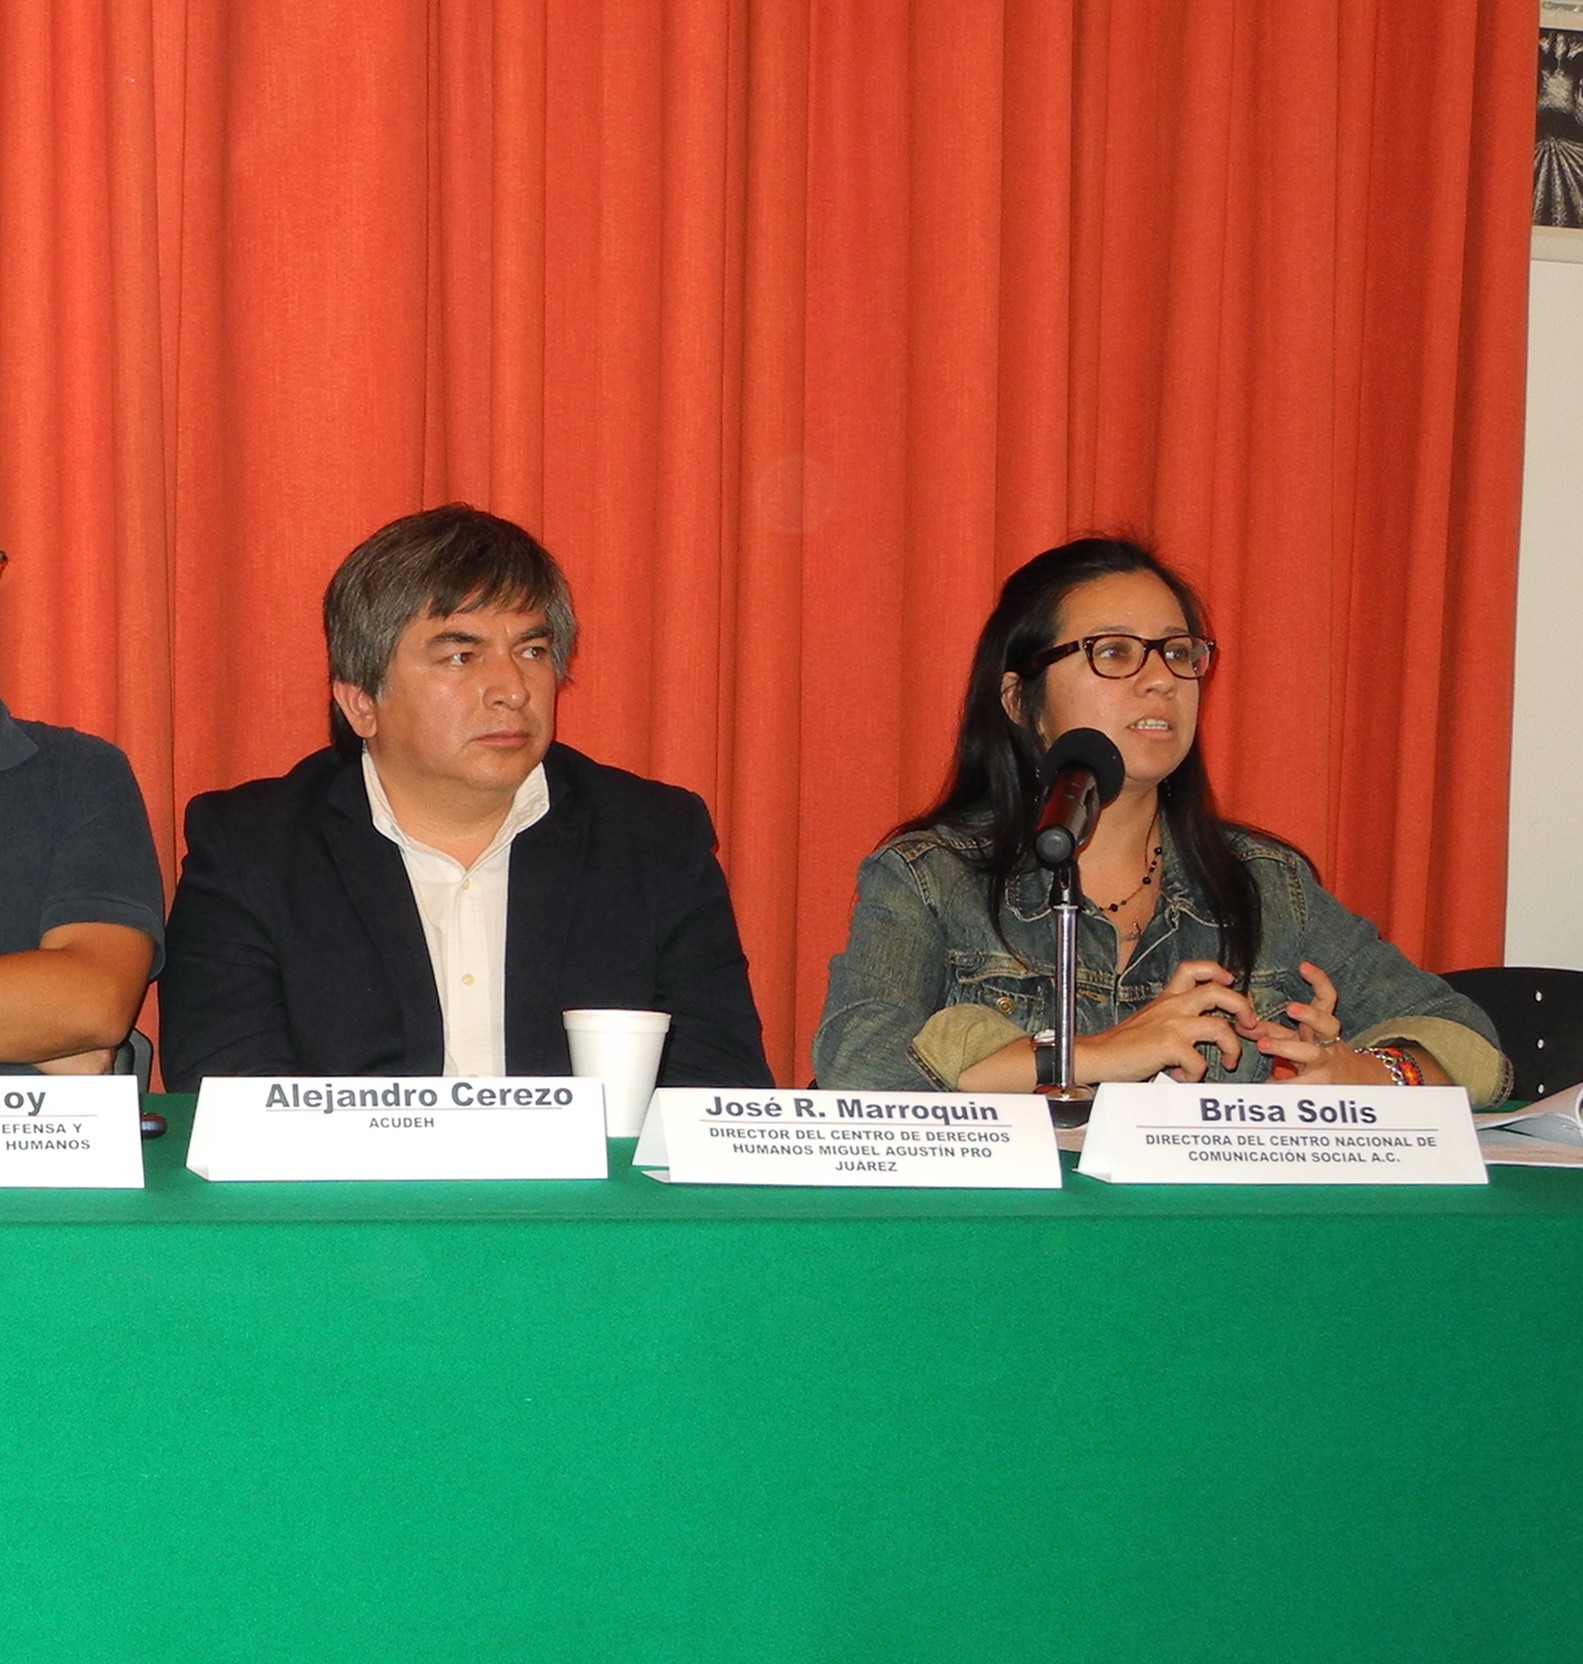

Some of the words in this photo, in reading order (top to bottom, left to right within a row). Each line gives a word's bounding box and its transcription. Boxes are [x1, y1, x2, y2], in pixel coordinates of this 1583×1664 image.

[264, 1082, 438, 1115] Alejandro
[450, 1081, 574, 1107] Cerezo
[705, 1095, 783, 1118] José
[792, 1097, 827, 1119] R.
[836, 1098, 1000, 1127] Marroquin
[1198, 1097, 1287, 1123] Brisa
[1296, 1098, 1378, 1125] Solis
[72, 1123, 83, 1134] Y
[369, 1116, 435, 1129] ACUDEH
[709, 1127, 791, 1140] DIRECTOR
[795, 1129, 826, 1140] DEL
[830, 1129, 895, 1141] CENTRO
[899, 1130, 921, 1142] DE
[925, 1131, 1011, 1144] DERECHOS
[1145, 1133, 1233, 1146] DIRECTORA
[1236, 1134, 1266, 1147] DEL
[1269, 1134, 1331, 1148] CENTRO
[1334, 1135, 1414, 1148] NACIONAL
[1415, 1136, 1438, 1148] DE
[5, 1139, 91, 1151] HUMANOS
[732, 1143, 814, 1156] HUMANOS
[818, 1144, 881, 1156] MIGUEL
[960, 1146, 993, 1159] PRO
[1310, 1151, 1368, 1164] SOCIAL
[1370, 1151, 1401, 1163] A.C.
